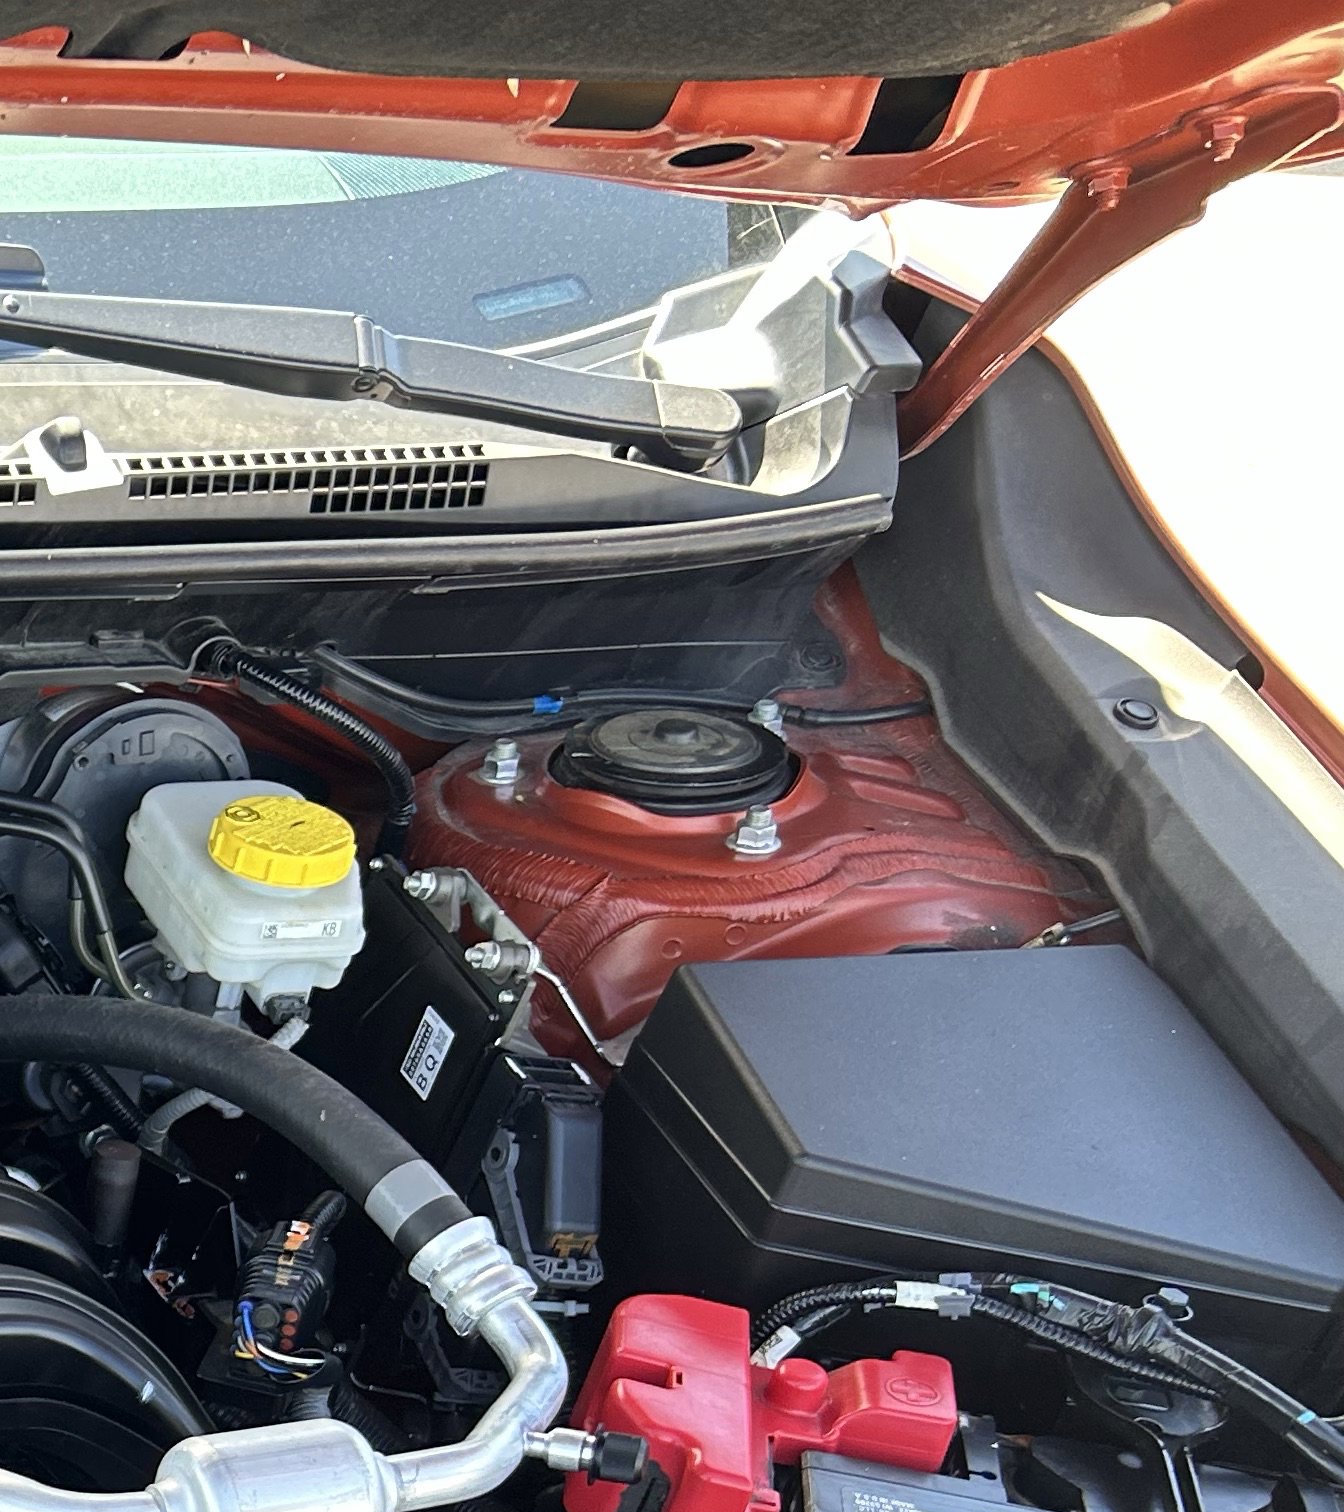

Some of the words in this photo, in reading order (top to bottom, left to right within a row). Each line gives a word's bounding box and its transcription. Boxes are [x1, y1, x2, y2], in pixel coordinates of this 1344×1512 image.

[321, 922, 337, 937] KB
[416, 1073, 428, 1091] B
[425, 1054, 438, 1072] Q
